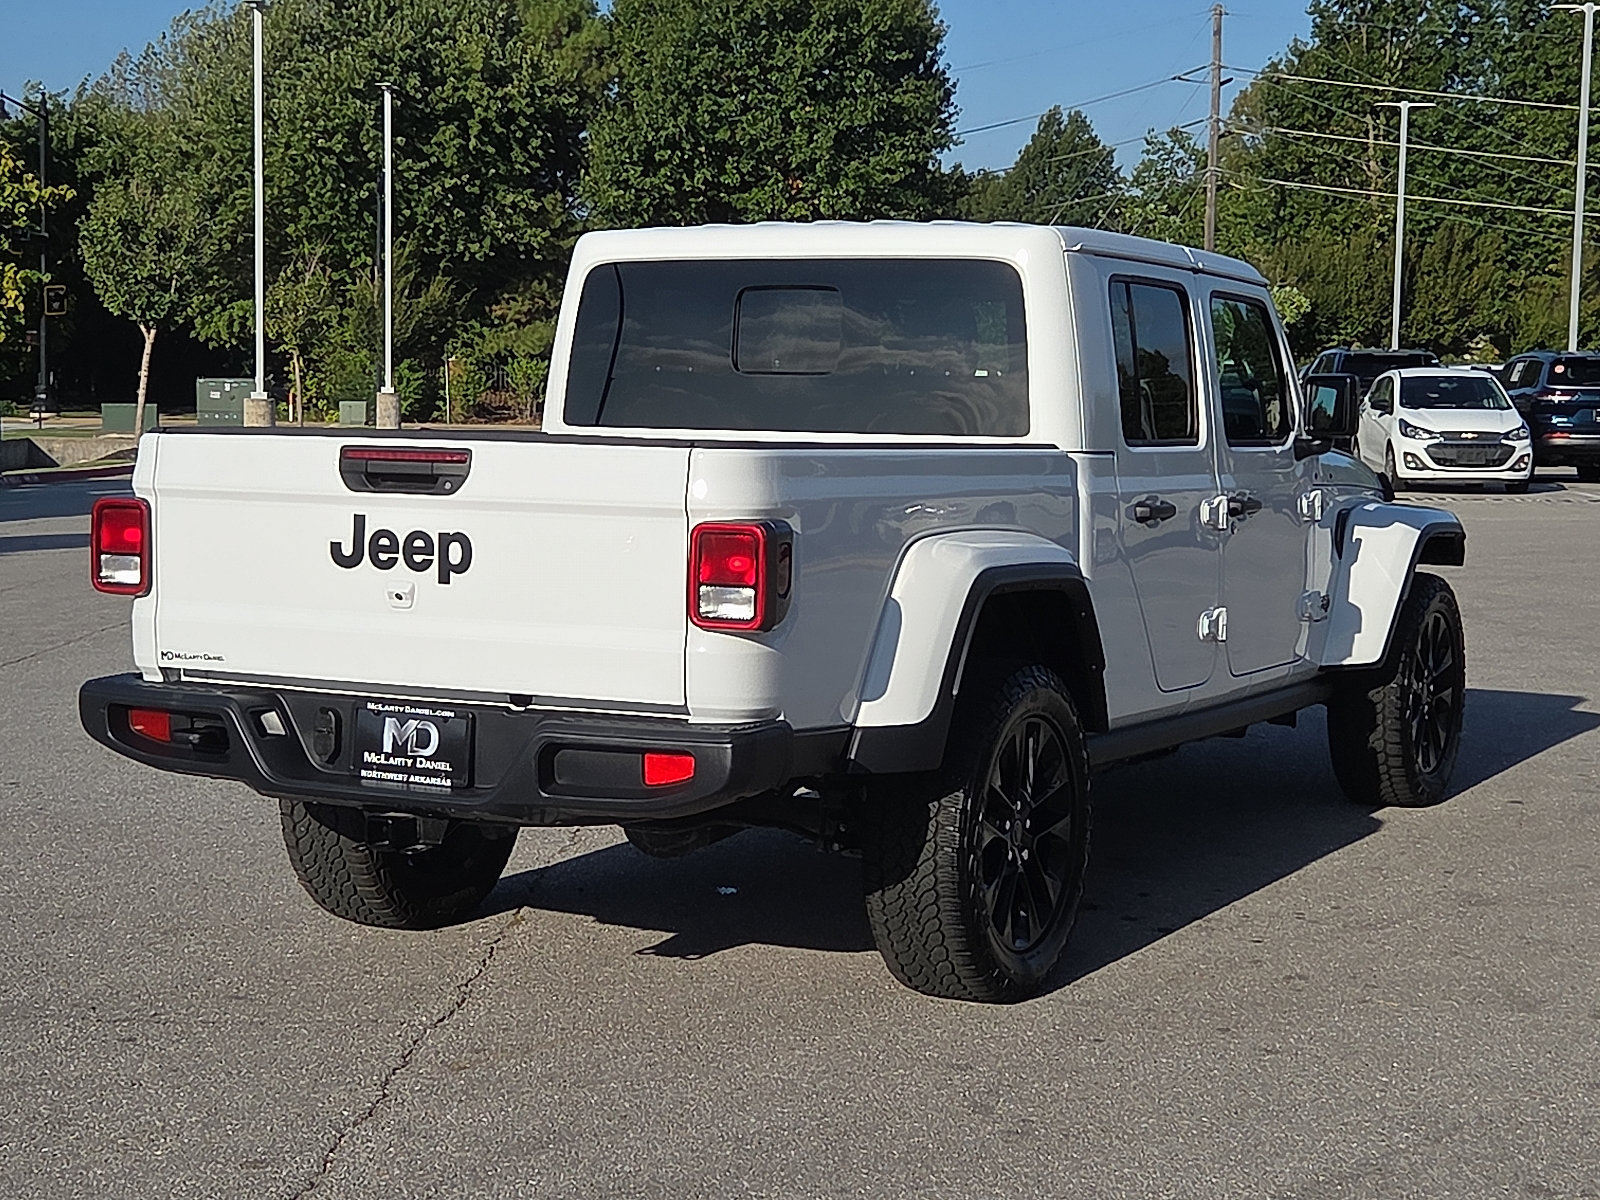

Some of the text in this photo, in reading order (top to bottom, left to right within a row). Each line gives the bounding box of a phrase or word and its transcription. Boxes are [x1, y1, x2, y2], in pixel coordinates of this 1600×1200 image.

[330, 513, 473, 585] Jeep
[383, 717, 439, 756] MD
[361, 770, 452, 786] NORTHWEST ARKANSAS
